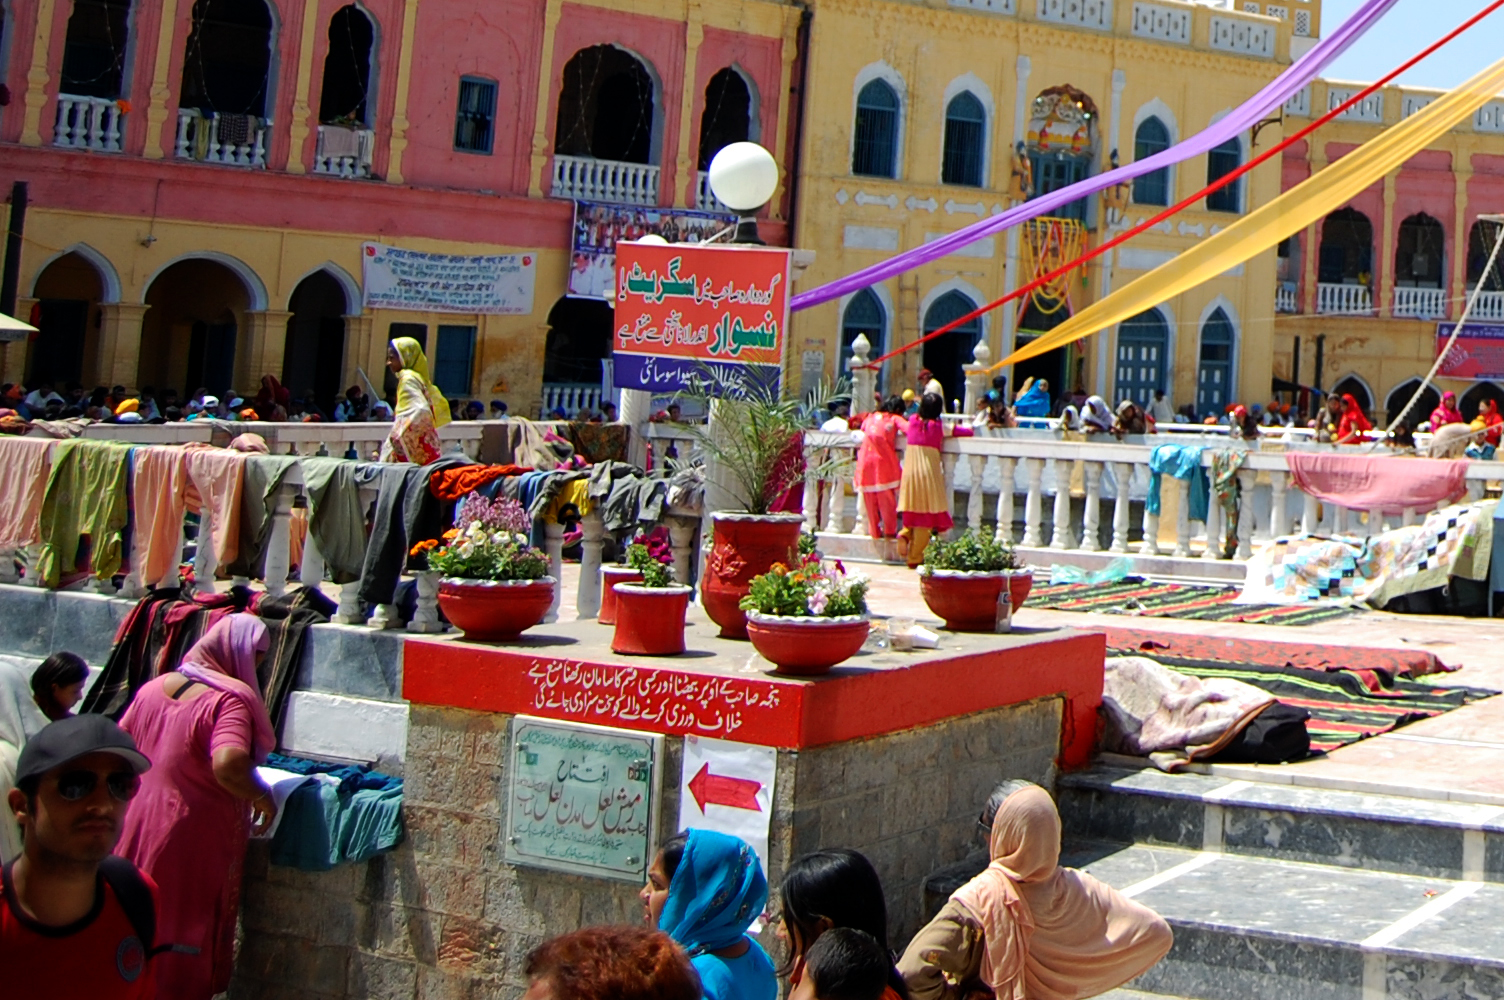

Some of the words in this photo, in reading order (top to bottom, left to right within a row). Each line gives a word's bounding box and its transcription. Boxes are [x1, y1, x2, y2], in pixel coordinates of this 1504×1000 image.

[619, 267, 627, 300] یا
[628, 256, 696, 304] سگریٹ
[695, 278, 711, 305] میں
[710, 281, 739, 309] صاحب
[618, 324, 634, 349] ہے
[634, 313, 652, 345] منع
[645, 327, 662, 342] سے
[663, 309, 682, 347] سختی
[707, 310, 777, 356] نسوار
[546, 660, 562, 688] منع
[583, 668, 614, 689] سامان
[614, 668, 627, 688] کا
[720, 679, 735, 694] کے
[725, 686, 759, 709] صاحب
[759, 685, 780, 709] پنجہ
[570, 692, 584, 713] دی
[583, 691, 599, 716] سزا
[596, 694, 615, 714] سخت
[612, 695, 626, 717] کو
[619, 695, 640, 719] والے
[641, 698, 669, 723] کرنے
[666, 703, 694, 727] ورزی
[697, 710, 742, 733] خلاف
[557, 760, 609, 784] افتتاح
